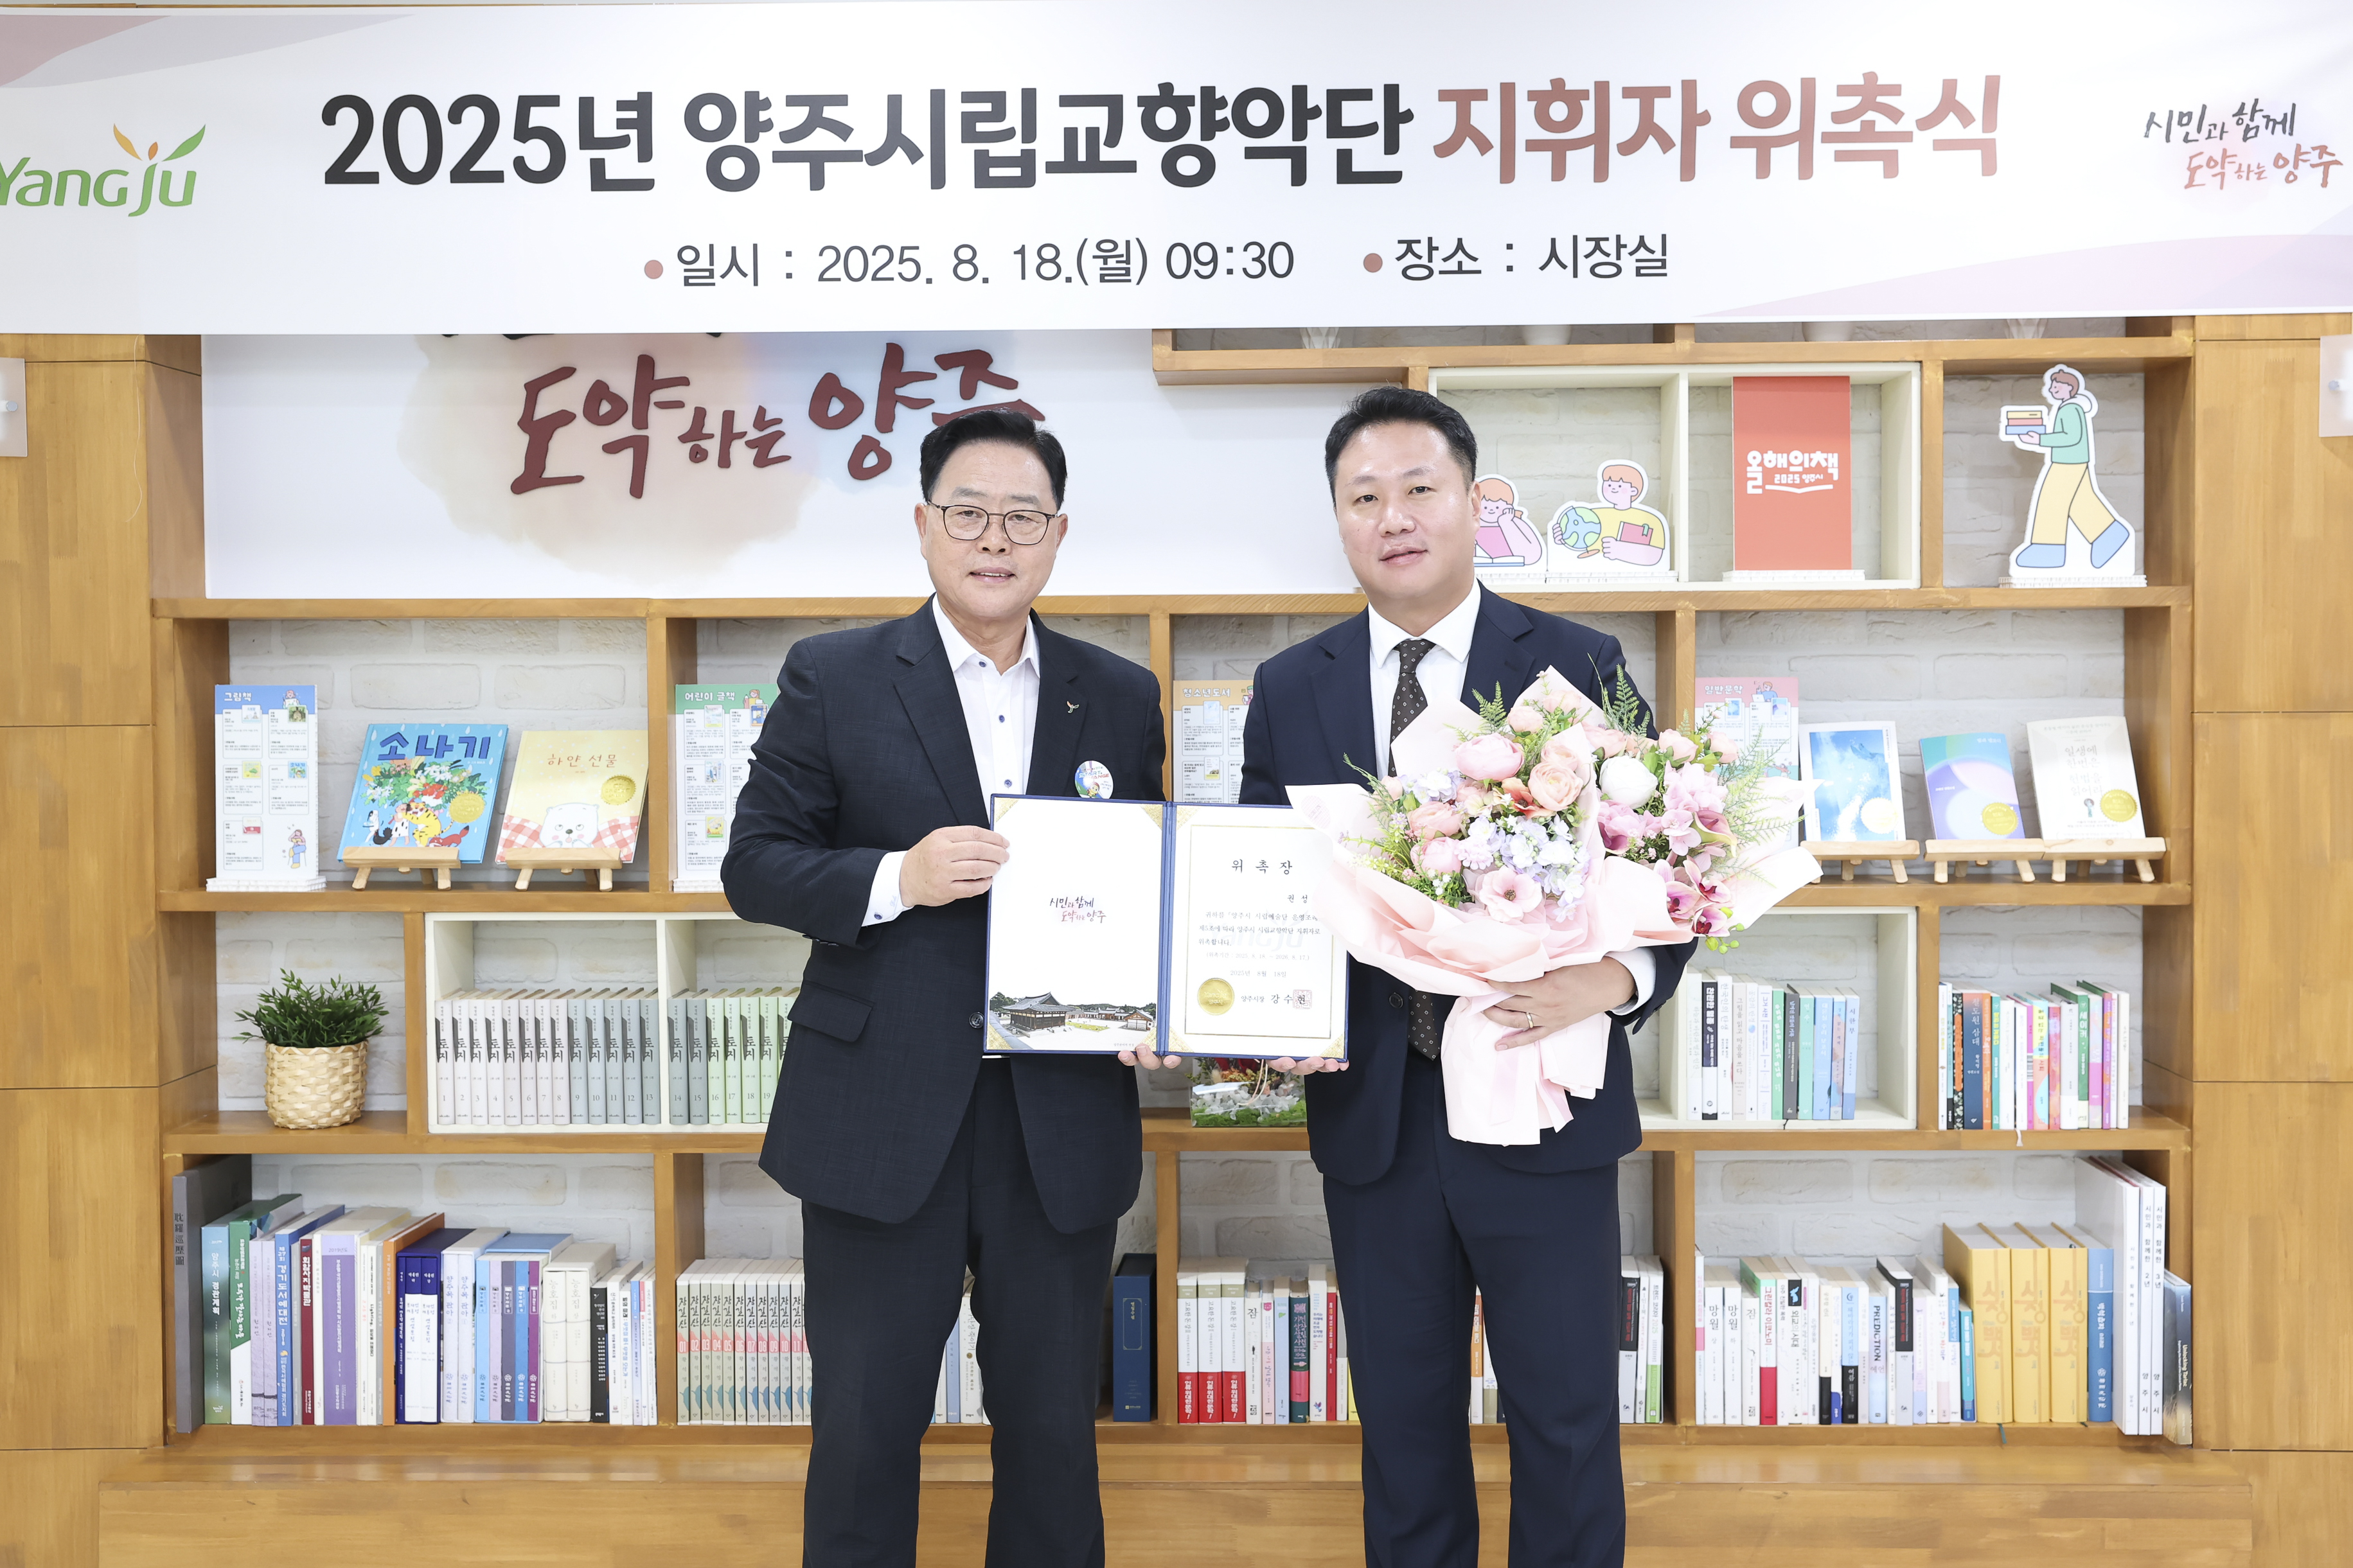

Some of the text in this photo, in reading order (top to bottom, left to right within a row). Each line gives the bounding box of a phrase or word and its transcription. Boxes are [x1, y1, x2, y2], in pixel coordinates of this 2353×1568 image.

[321, 71, 2000, 192] 2025년 양주시립교향악단 지휘자 위촉식
[2144, 98, 2296, 143] 시민과 함께
[2184, 143, 2343, 190] 도약하는 양주
[677, 243, 758, 286] 일시
[818, 245, 932, 284] 2025.
[953, 244, 989, 283] 8.
[1013, 238, 1147, 286] 18.(월)
[1166, 242, 1293, 279] 09:30
[1395, 237, 1482, 281] 장소
[1538, 234, 1667, 278] 시장실
[510, 354, 792, 498] 도약하는
[1774, 473, 1824, 484] 2025 양주시
[224, 692, 252, 701] 그림책
[685, 692, 735, 701] 어린이 글책
[1182, 688, 1230, 698] 청소년도서
[1705, 685, 1743, 695] 일반문학
[377, 731, 492, 761] 소나기
[2065, 745, 2097, 757] 일생에
[547, 753, 617, 768] 하얀 선물
[1050, 895, 1094, 908] 시민과 함께
[1061, 910, 1106, 923] 도약하는 양주
[1255, 912, 1288, 921] 시립예술단
[439, 1039, 448, 1063] 토지
[456, 1038, 466, 1062] 토지
[472, 1039, 482, 1063] 토지
[490, 1039, 500, 1063] 토지
[506, 1039, 516, 1063] 토지
[524, 1038, 534, 1063] 토지
[538, 1038, 549, 1063] 토지
[554, 1038, 564, 1063] 토지
[572, 1038, 582, 1063] 토지
[591, 1038, 601, 1063] 토지
[608, 1038, 619, 1063] 토지
[626, 1039, 636, 1063] 토지
[644, 1038, 654, 1062] 토지
[674, 1038, 682, 1063] 토지
[693, 1038, 702, 1063] 토지
[711, 1037, 720, 1062] 토지
[728, 1037, 737, 1061] 토지
[747, 1036, 756, 1061] 토지
[763, 1036, 772, 1061] 토지
[278, 1265, 288, 1326] 경기도서예대전
[679, 1296, 688, 1328] 장길산
[690, 1295, 699, 1327] 장길산
[702, 1295, 710, 1326] 장길산
[713, 1295, 721, 1327] 장길산
[724, 1296, 732, 1328] 장길산
[735, 1296, 744, 1328] 장길산
[747, 1296, 756, 1328] 장길산
[758, 1296, 767, 1328] 장길산
[770, 1296, 778, 1328] 장길산
[780, 1296, 789, 1328] 장길산
[792, 1296, 801, 1328] 장길산
[1247, 1307, 1259, 1319] 잠
[1746, 1308, 1756, 1319] 잠
[680, 1342, 686, 1352] 01
[691, 1341, 699, 1351] 02
[702, 1340, 709, 1350] 03
[713, 1340, 721, 1350] 04
[724, 1341, 732, 1352] 05
[736, 1341, 744, 1352] 06
[748, 1341, 756, 1352] 07
[759, 1341, 767, 1352] 08
[770, 1341, 777, 1352] 09
[782, 1341, 788, 1352] 10
[794, 1341, 801, 1352] 11
